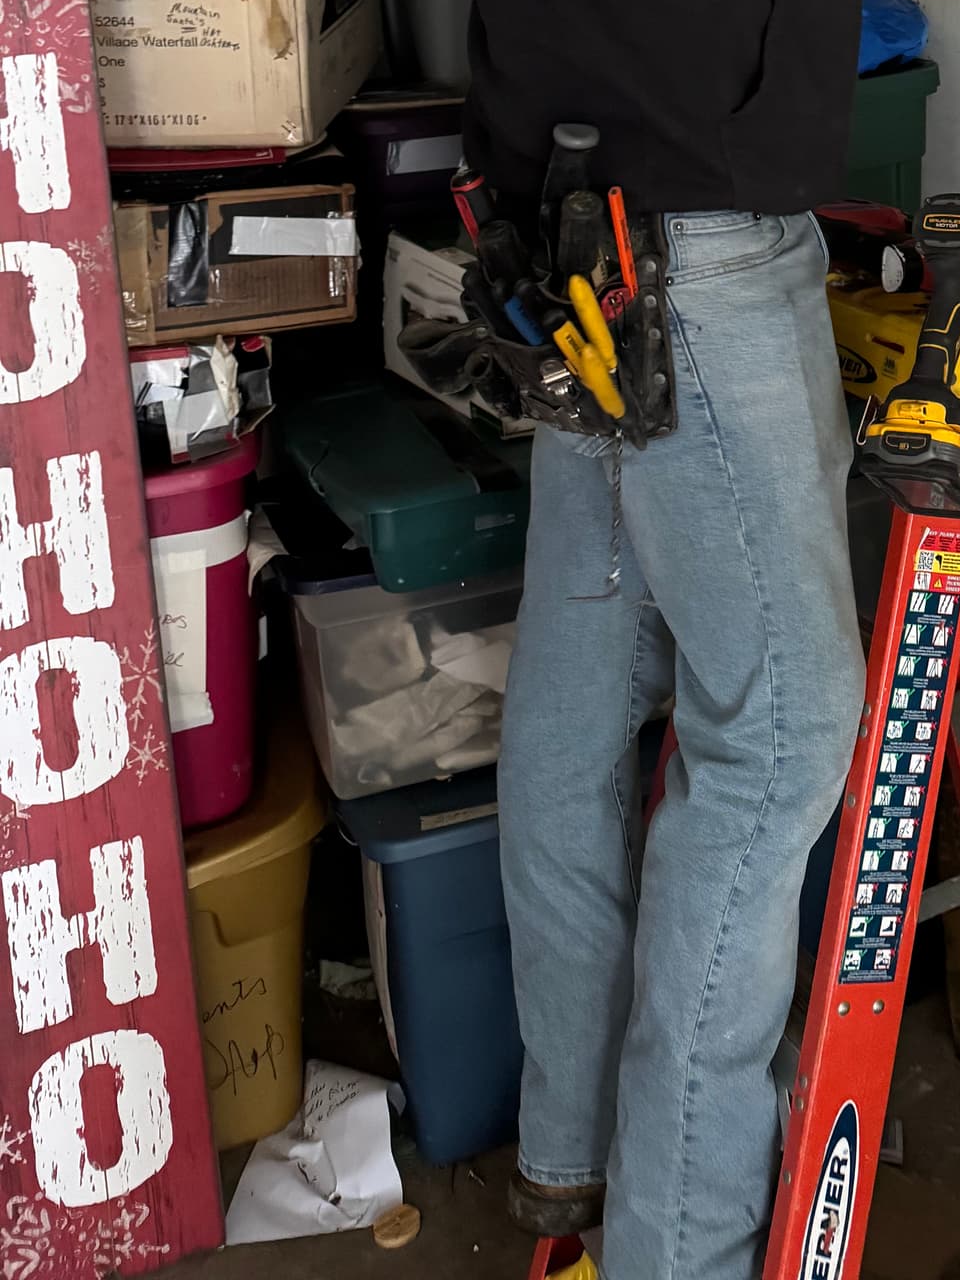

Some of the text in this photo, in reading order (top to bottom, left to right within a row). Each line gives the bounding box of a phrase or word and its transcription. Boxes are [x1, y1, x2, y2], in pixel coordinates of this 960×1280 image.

[95, 16, 135, 27] 52644
[142, 36, 198, 48] Waterfall
[98, 55, 126, 67] One
